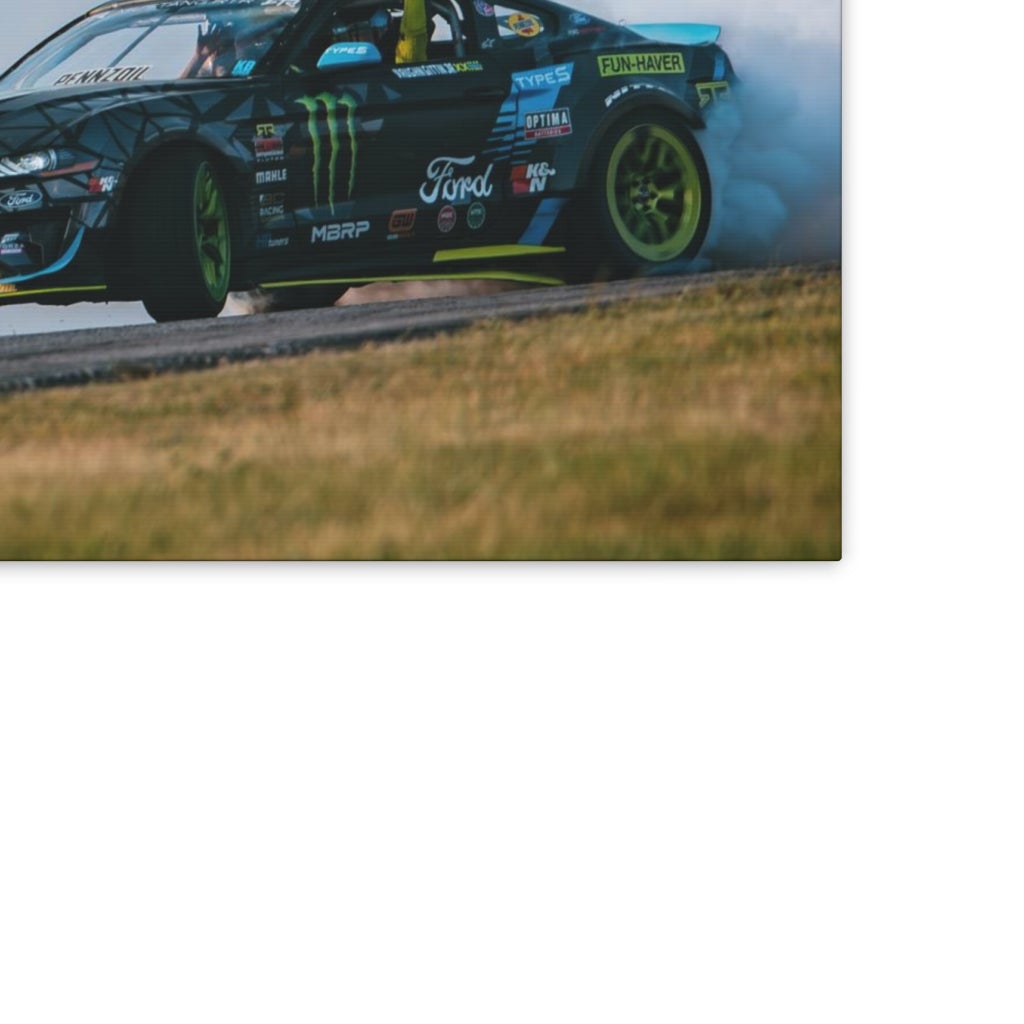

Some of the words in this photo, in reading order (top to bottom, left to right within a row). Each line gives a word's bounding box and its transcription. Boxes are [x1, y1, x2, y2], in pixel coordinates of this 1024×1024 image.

[601, 55, 683, 75] FUN-HAVER
[525, 110, 569, 130] OPTIMA
[256, 168, 288, 184] MAHLE
[419, 155, 494, 204] Ford
[7, 194, 33, 206] Ford
[311, 220, 371, 243] MBRP
